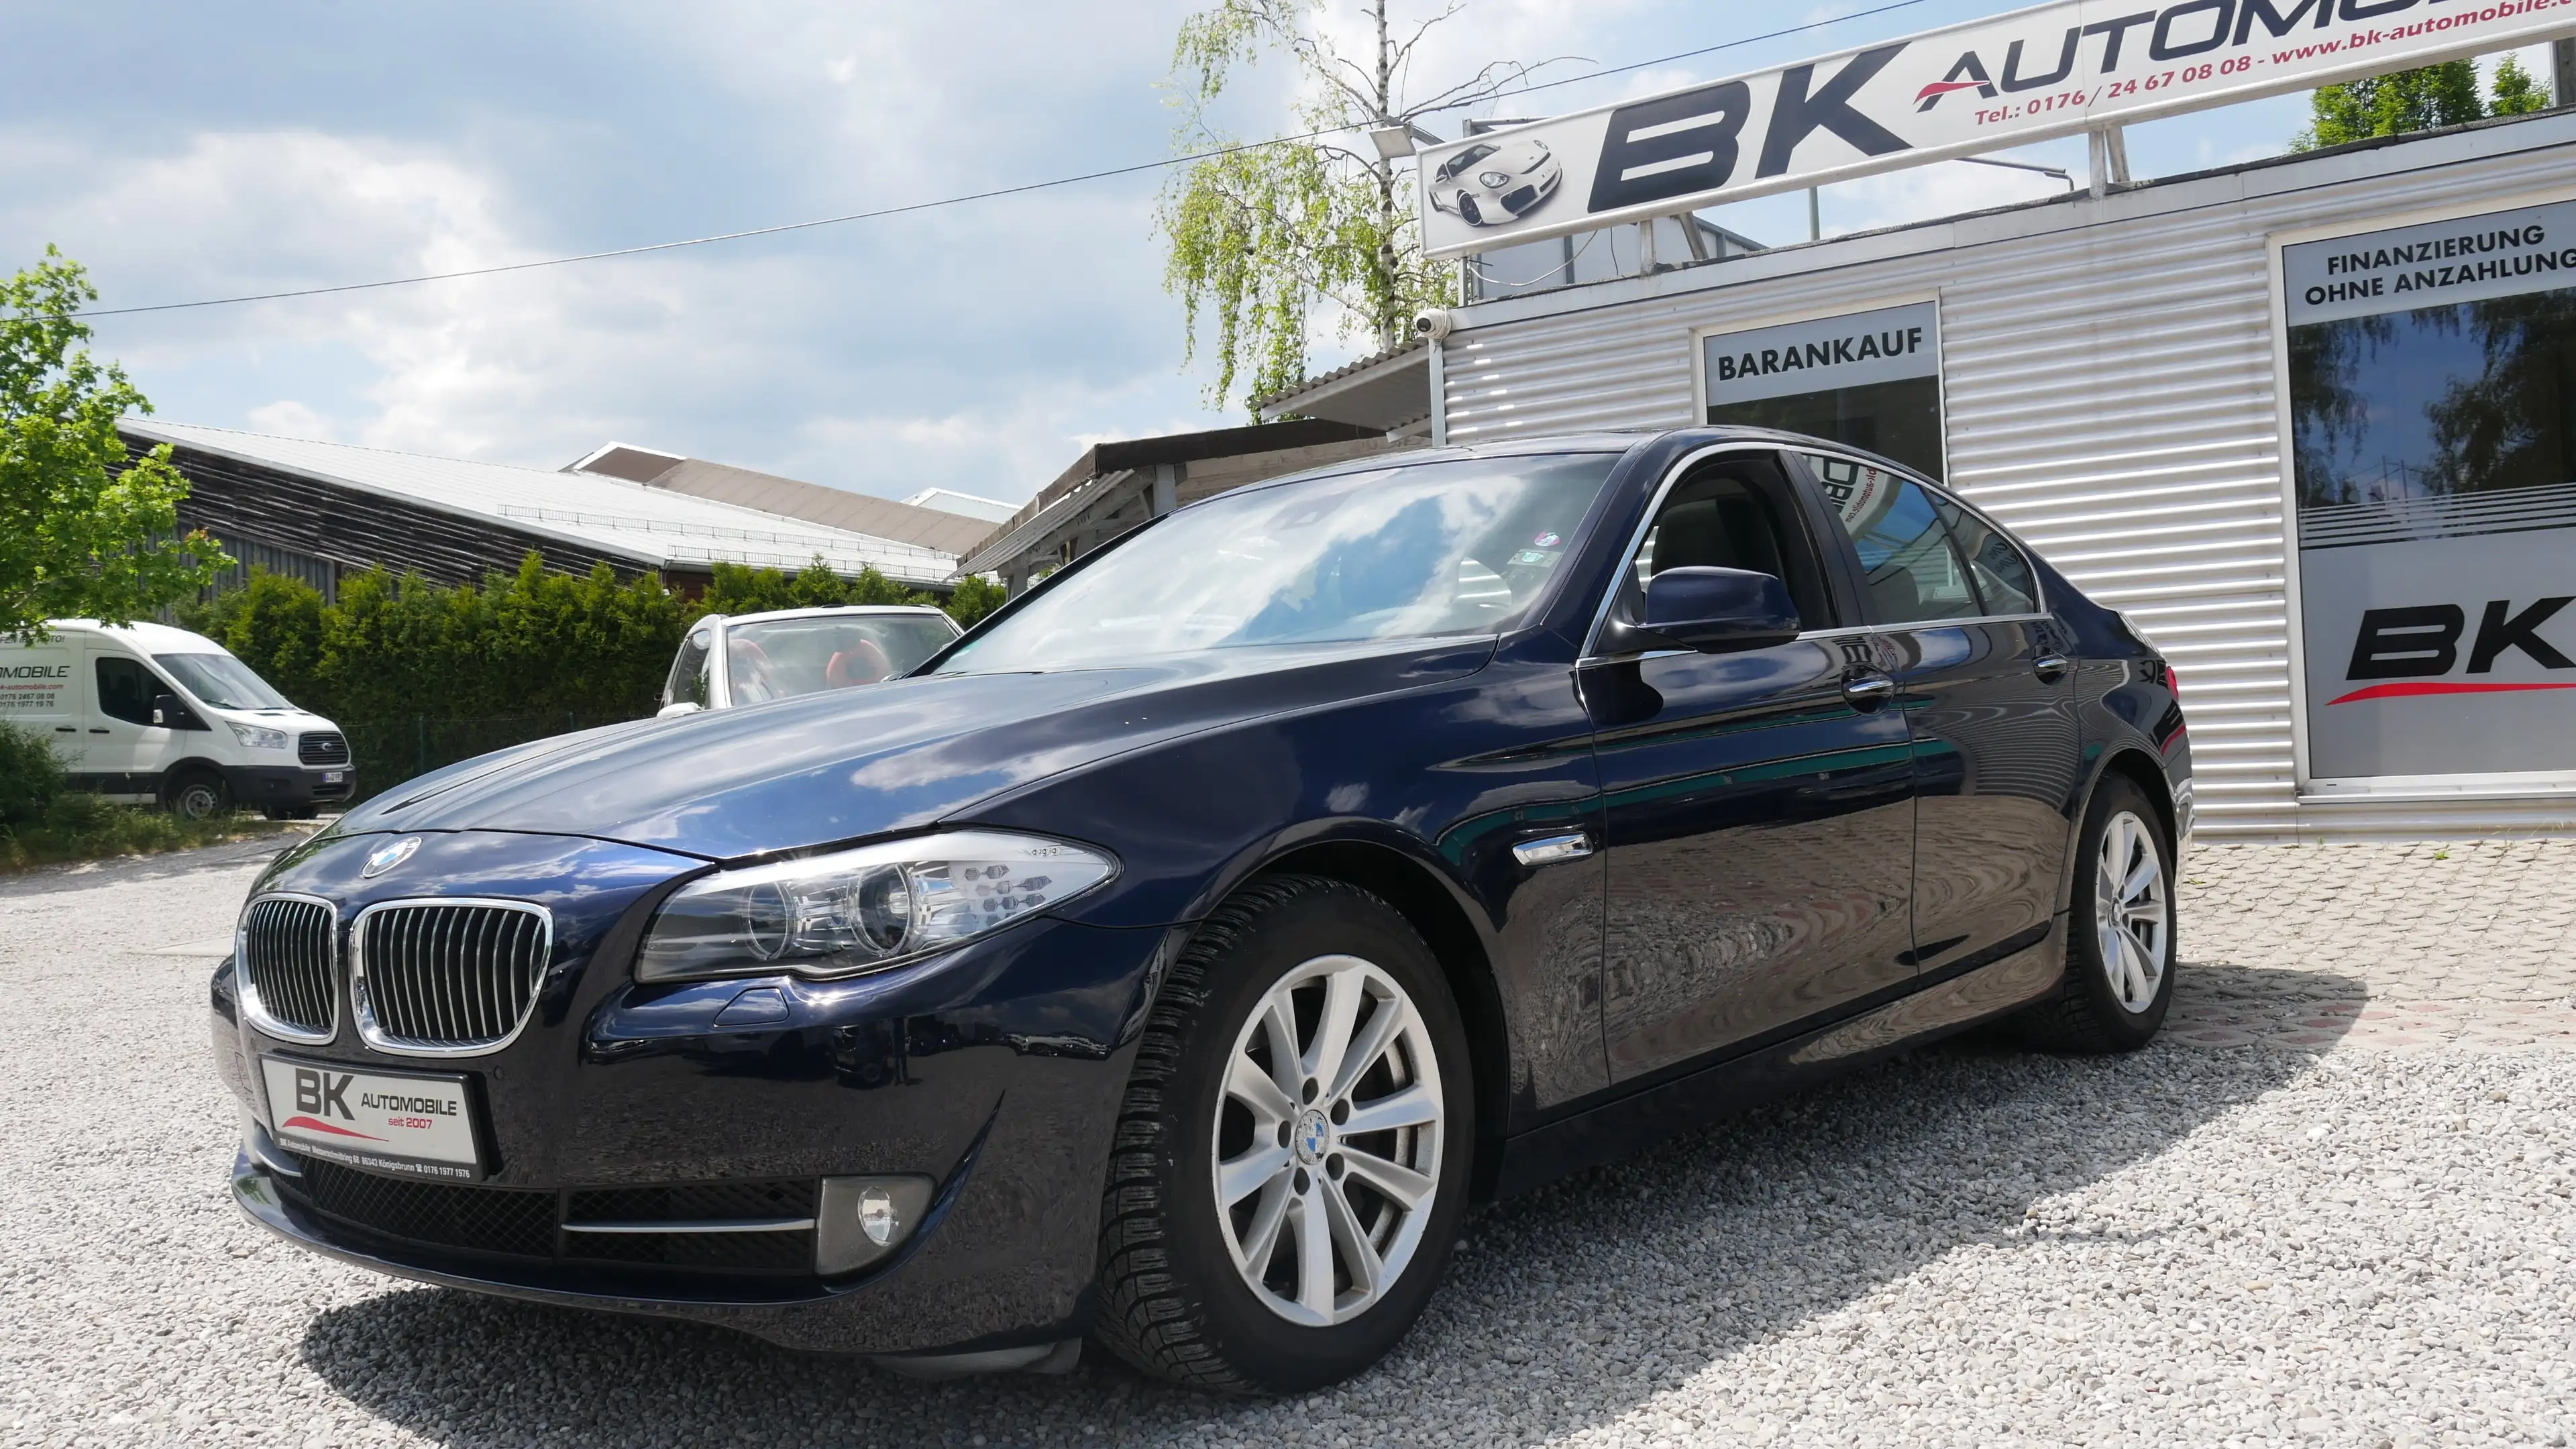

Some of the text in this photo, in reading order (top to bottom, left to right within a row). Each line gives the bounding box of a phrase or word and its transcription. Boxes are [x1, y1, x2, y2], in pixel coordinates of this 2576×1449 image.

[1974, 105, 2020, 125] Tel.:
[2027, 89, 2086, 115] 0176
[2108, 78, 2138, 99] 24
[2145, 72, 2175, 91] 67
[2182, 63, 2213, 82] 08
[2220, 55, 2251, 75] 08
[1587, 42, 1914, 213] BK
[2327, 225, 2544, 275] FINANZIERUNG
[2305, 248, 2576, 306] OHNE ANZAHLUNG
[1719, 327, 1922, 381] BARANKAUF
[2346, 596, 2576, 681] BK
[0, 665, 70, 678] MOBILE
[294, 1068, 457, 1121] BK AUTOMOBILE
[388, 1117, 433, 1130] seit 2007
[378, 1159, 415, 1172] Königsbrunn
[423, 1165, 439, 1175] 0176
[439, 1167, 453, 1176] 1977
[455, 1169, 470, 1178] 1976
